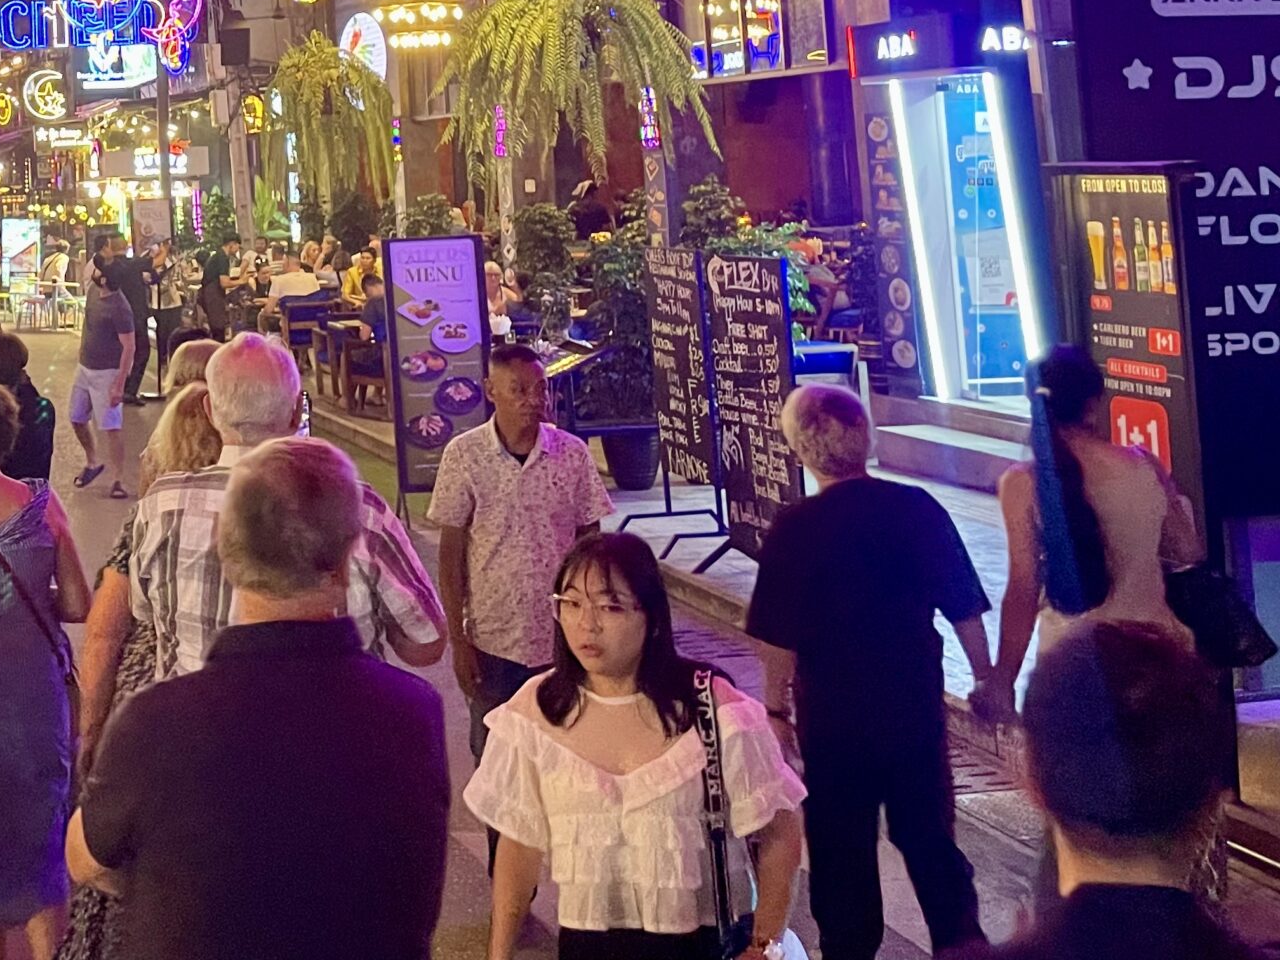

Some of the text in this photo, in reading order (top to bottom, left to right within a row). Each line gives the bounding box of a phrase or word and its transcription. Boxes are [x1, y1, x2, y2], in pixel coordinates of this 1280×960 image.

[877, 33, 915, 60] ABA
[1173, 54, 1280, 100] DJ
[956, 83, 979, 94] ABA
[1081, 178, 1167, 194] FROM OPEN TO CLOSE
[404, 264, 463, 283] MENU
[723, 259, 761, 290] FLEX
[748, 322, 769, 341] SHOT
[1155, 331, 1174, 353] 1+1
[1110, 361, 1160, 379] ALL COCKTAILS
[1116, 414, 1160, 458] 1+1
